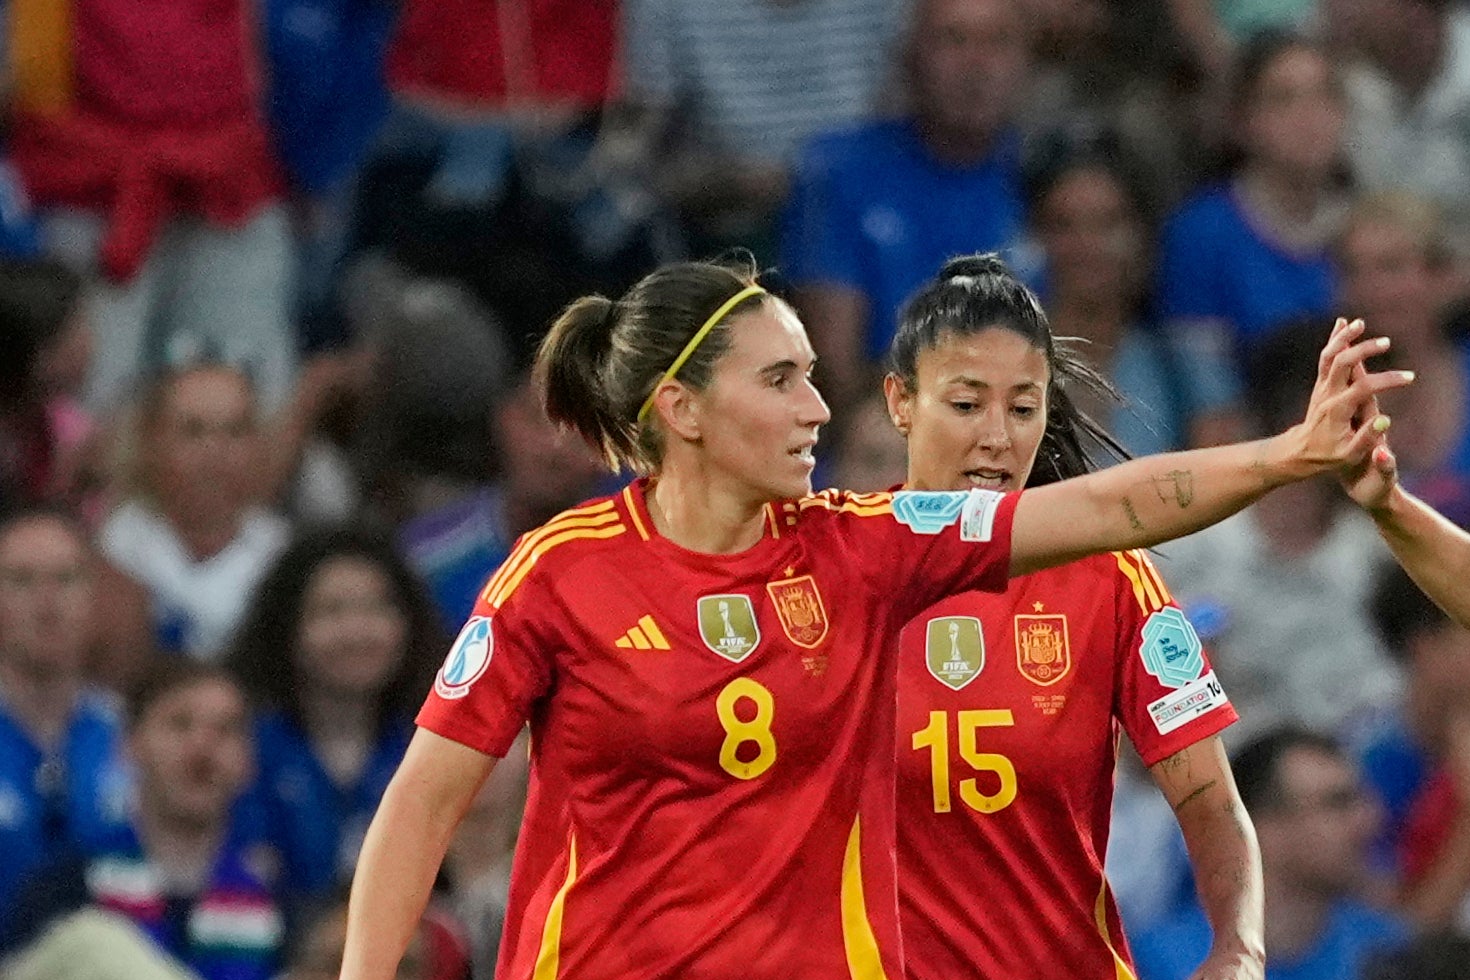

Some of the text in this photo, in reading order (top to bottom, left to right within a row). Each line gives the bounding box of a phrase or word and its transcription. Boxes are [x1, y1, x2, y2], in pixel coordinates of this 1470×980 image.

[943, 661, 968, 671] FIFA
[716, 677, 776, 780] 8
[912, 709, 1017, 814] 15
